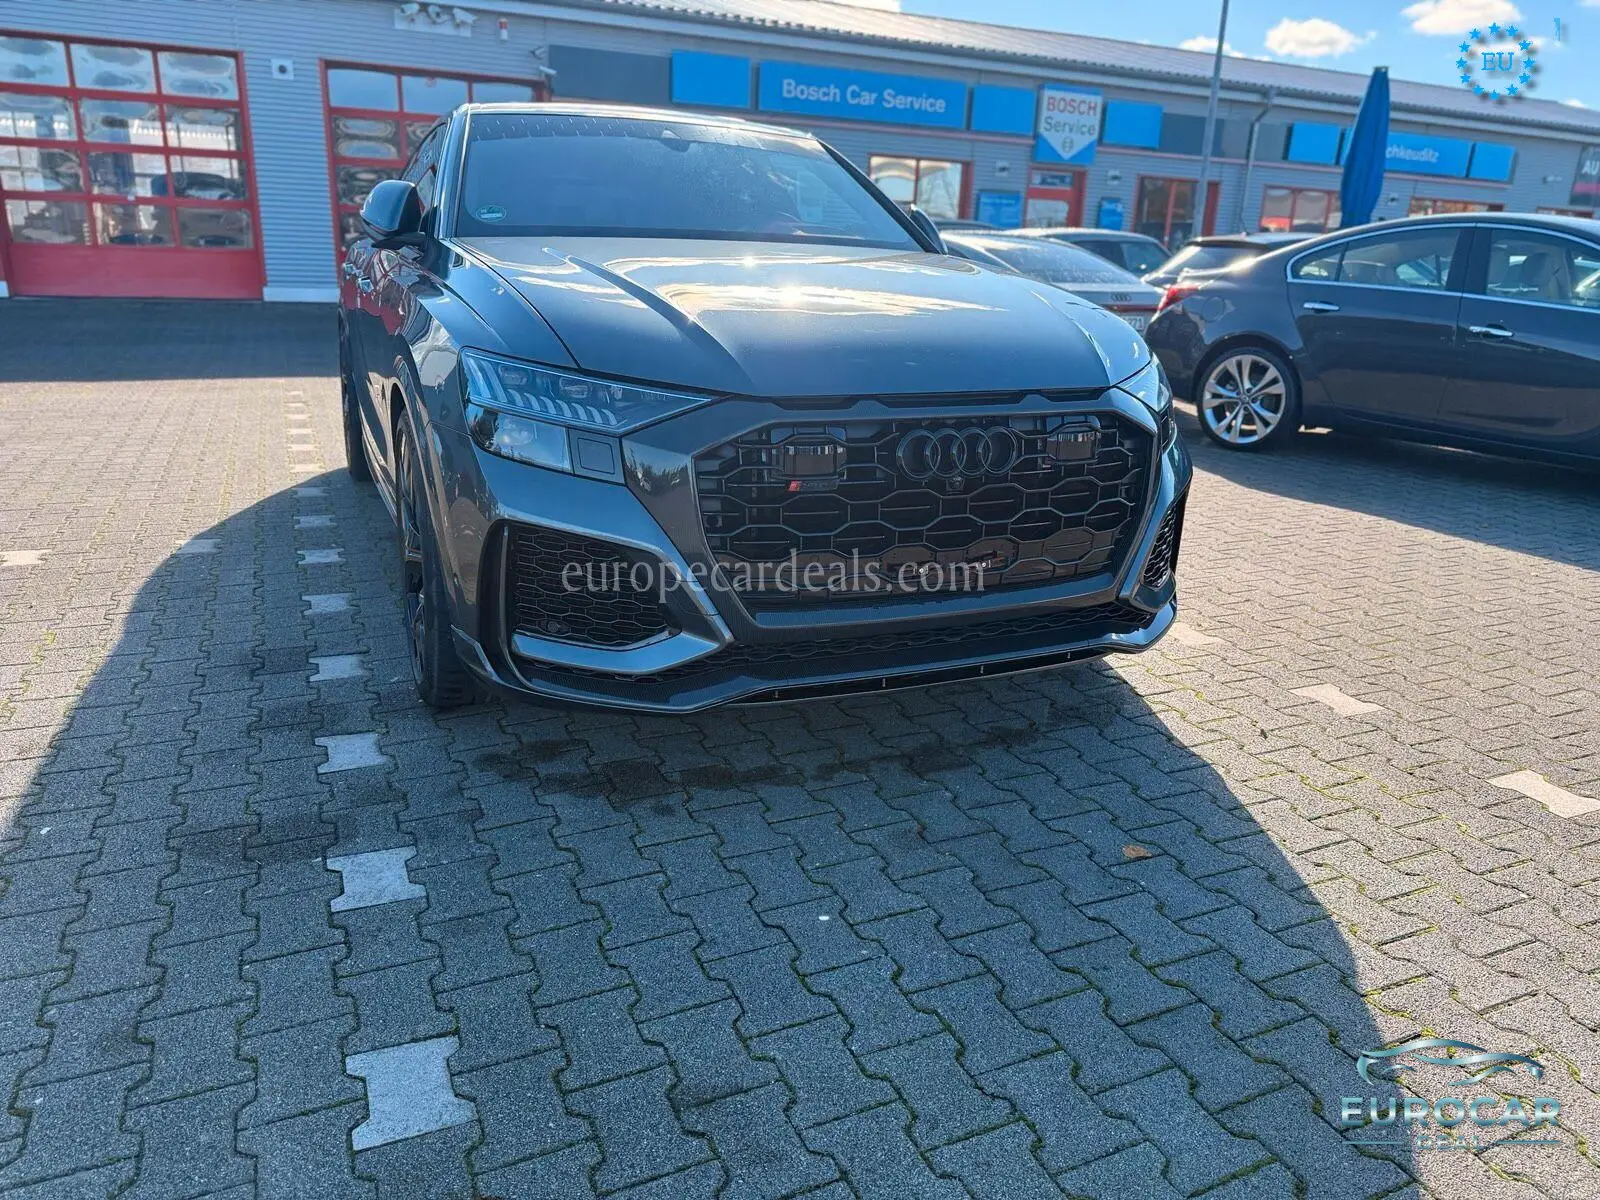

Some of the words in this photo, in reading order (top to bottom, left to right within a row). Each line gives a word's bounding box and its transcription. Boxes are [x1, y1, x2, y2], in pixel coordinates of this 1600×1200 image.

[782, 79, 840, 102] Bosch
[846, 85, 878, 105] Car
[882, 89, 946, 112] Service
[1047, 96, 1098, 116] BOSCH
[1043, 116, 1097, 136] Service
